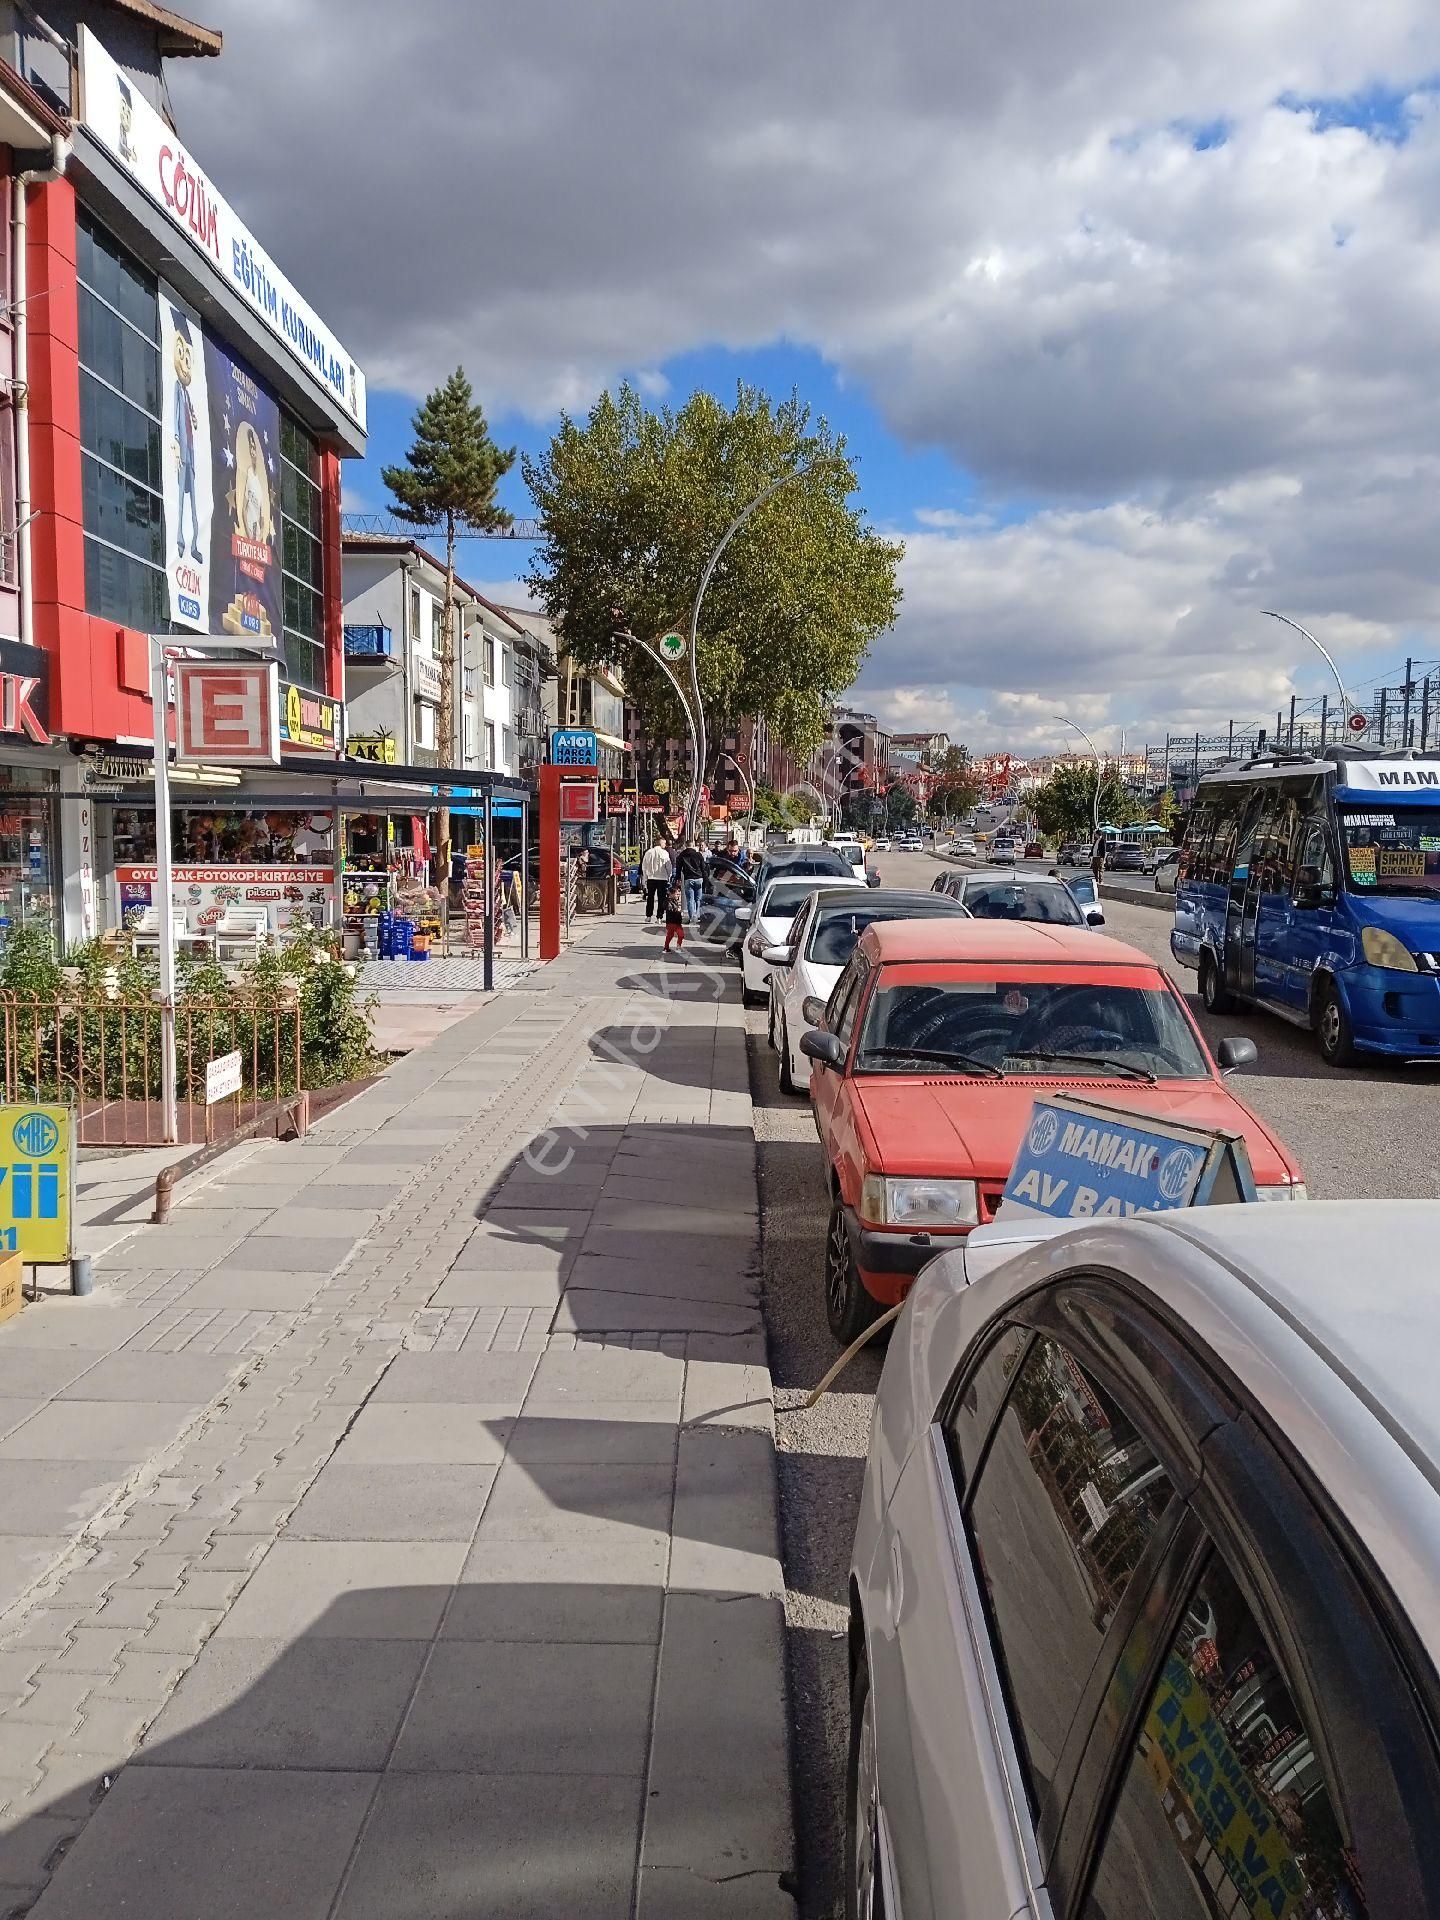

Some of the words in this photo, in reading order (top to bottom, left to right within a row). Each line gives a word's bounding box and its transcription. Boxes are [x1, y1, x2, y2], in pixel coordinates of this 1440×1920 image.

[231, 237, 278, 323] EĞİTİM
[281, 297, 345, 398] KURUMLARI
[179, 599, 199, 618] KURS
[243, 614, 260, 631] KURS
[556, 748, 592, 757] HARCA
[556, 757, 592, 765] HARCA
[1343, 814, 1370, 827] MAMAK
[131, 868, 324, 882] OYUCAK-FOTOKOPİ-KIRTASİYE
[247, 887, 279, 897] pilsan
[15, 1116, 55, 1154] MKE
[1057, 1122, 1159, 1180] MAMAK
[1012, 1169, 1068, 1208] AV
